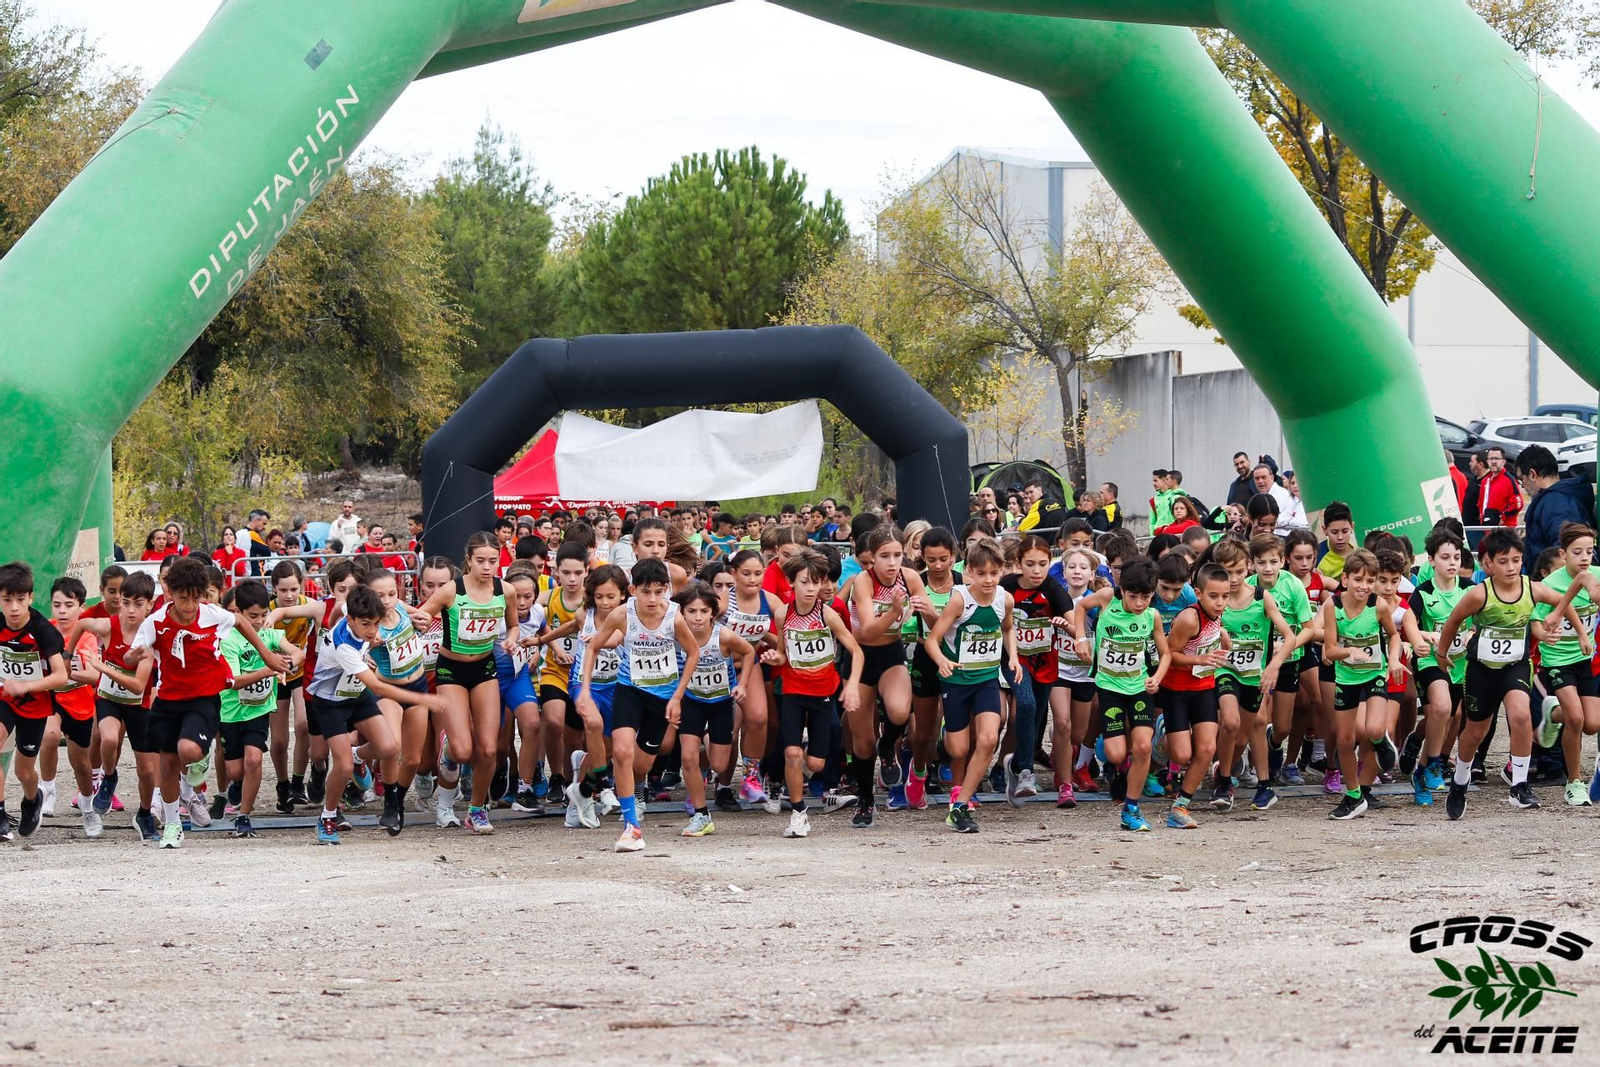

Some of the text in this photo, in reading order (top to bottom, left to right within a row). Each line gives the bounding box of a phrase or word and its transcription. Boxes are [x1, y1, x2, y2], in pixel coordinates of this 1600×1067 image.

[189, 84, 359, 299] DIPUTACIÓN
[227, 145, 343, 295] DE JAÉN
[596, 551, 609, 559] 099
[465, 618, 498, 634] 472
[731, 622, 764, 635] 1149
[1016, 627, 1045, 643] 304
[396, 634, 418, 661] 217
[423, 642, 440, 656] 13
[794, 638, 826, 655] 140
[967, 640, 998, 655] 484
[1057, 637, 1076, 652] 12
[1491, 639, 1512, 655] 92
[635, 655, 669, 671] 1111
[1105, 650, 1138, 667] 545
[1227, 650, 1256, 665] 459
[2, 660, 34, 676] 305
[244, 677, 271, 694] 486
